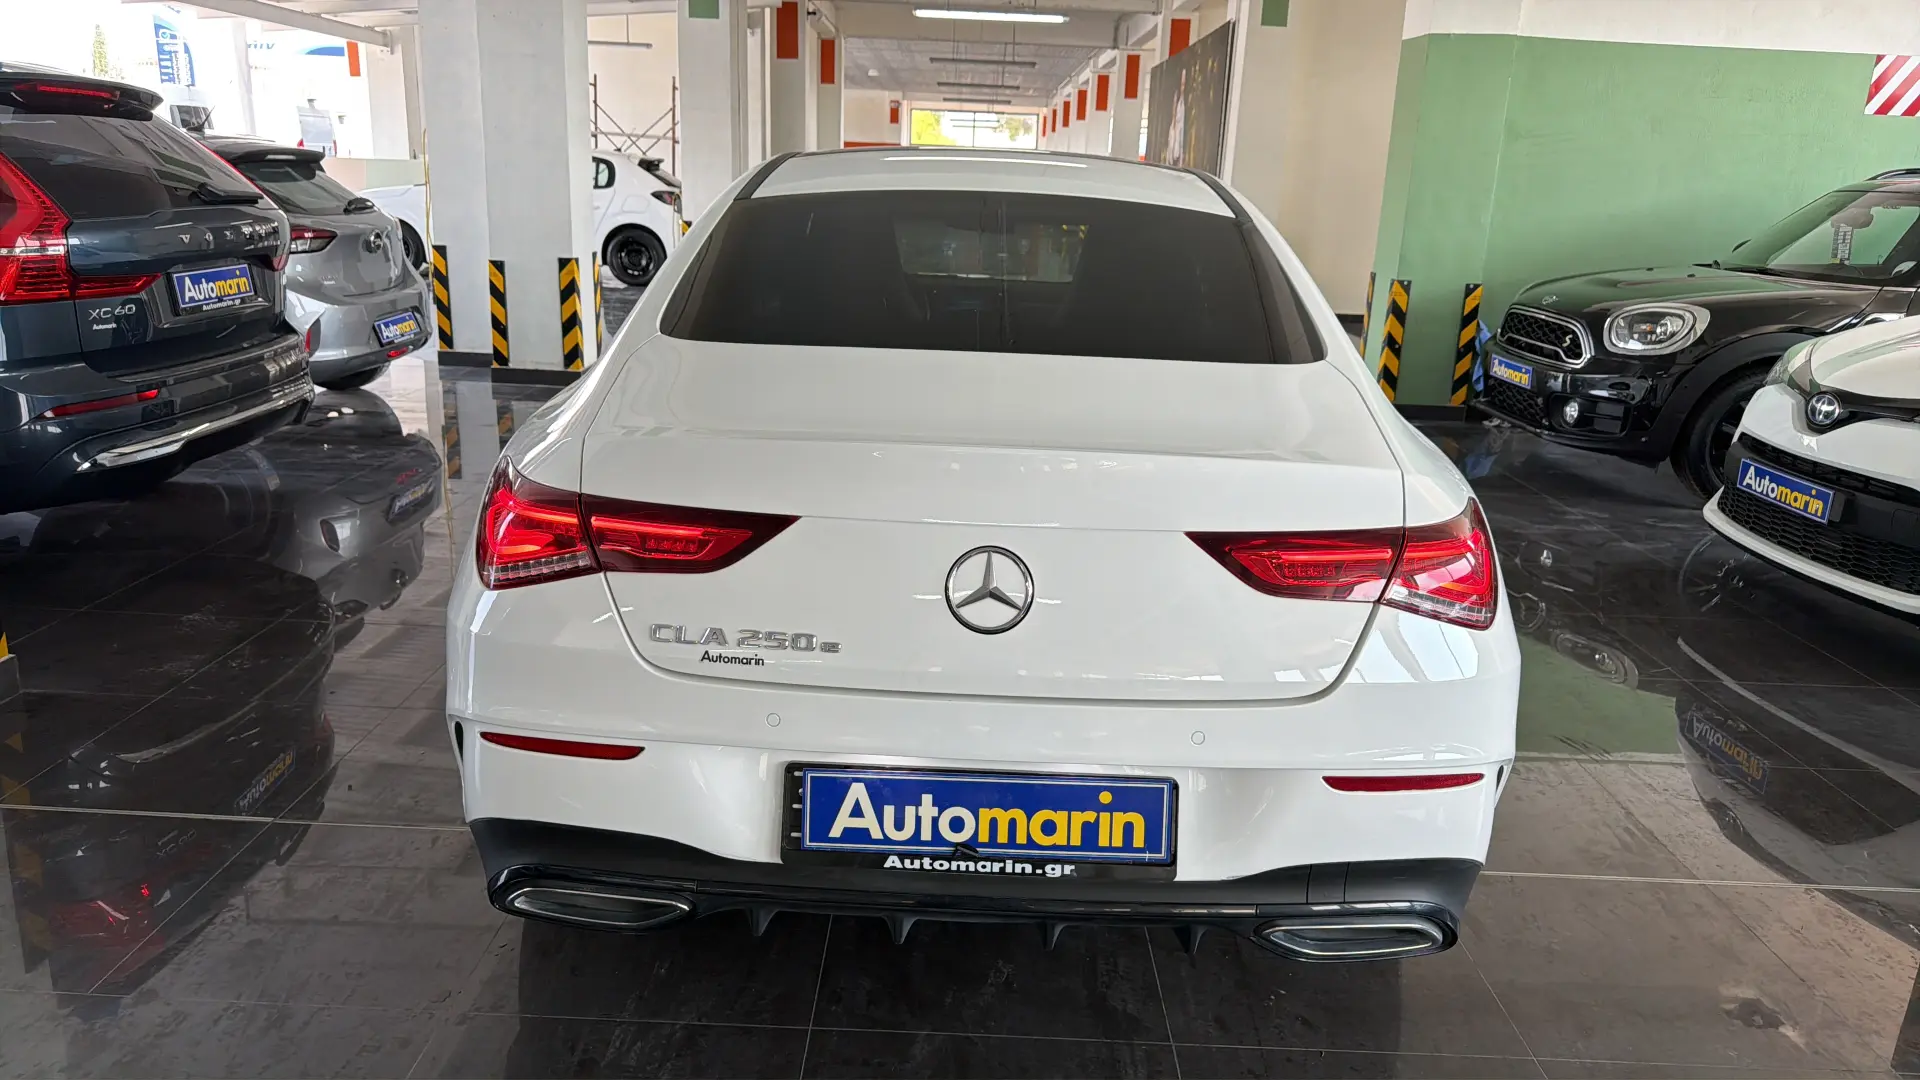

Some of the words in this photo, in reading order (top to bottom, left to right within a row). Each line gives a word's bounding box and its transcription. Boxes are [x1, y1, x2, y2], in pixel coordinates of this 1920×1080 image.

[184, 269, 250, 303] Automarin
[1492, 357, 1529, 385] Automarin
[1742, 465, 1824, 517] Automarin
[650, 623, 729, 647] CLA
[700, 650, 765, 666] Automarin
[828, 782, 1145, 848] Automarin
[883, 855, 1076, 877] Automarin.gr
